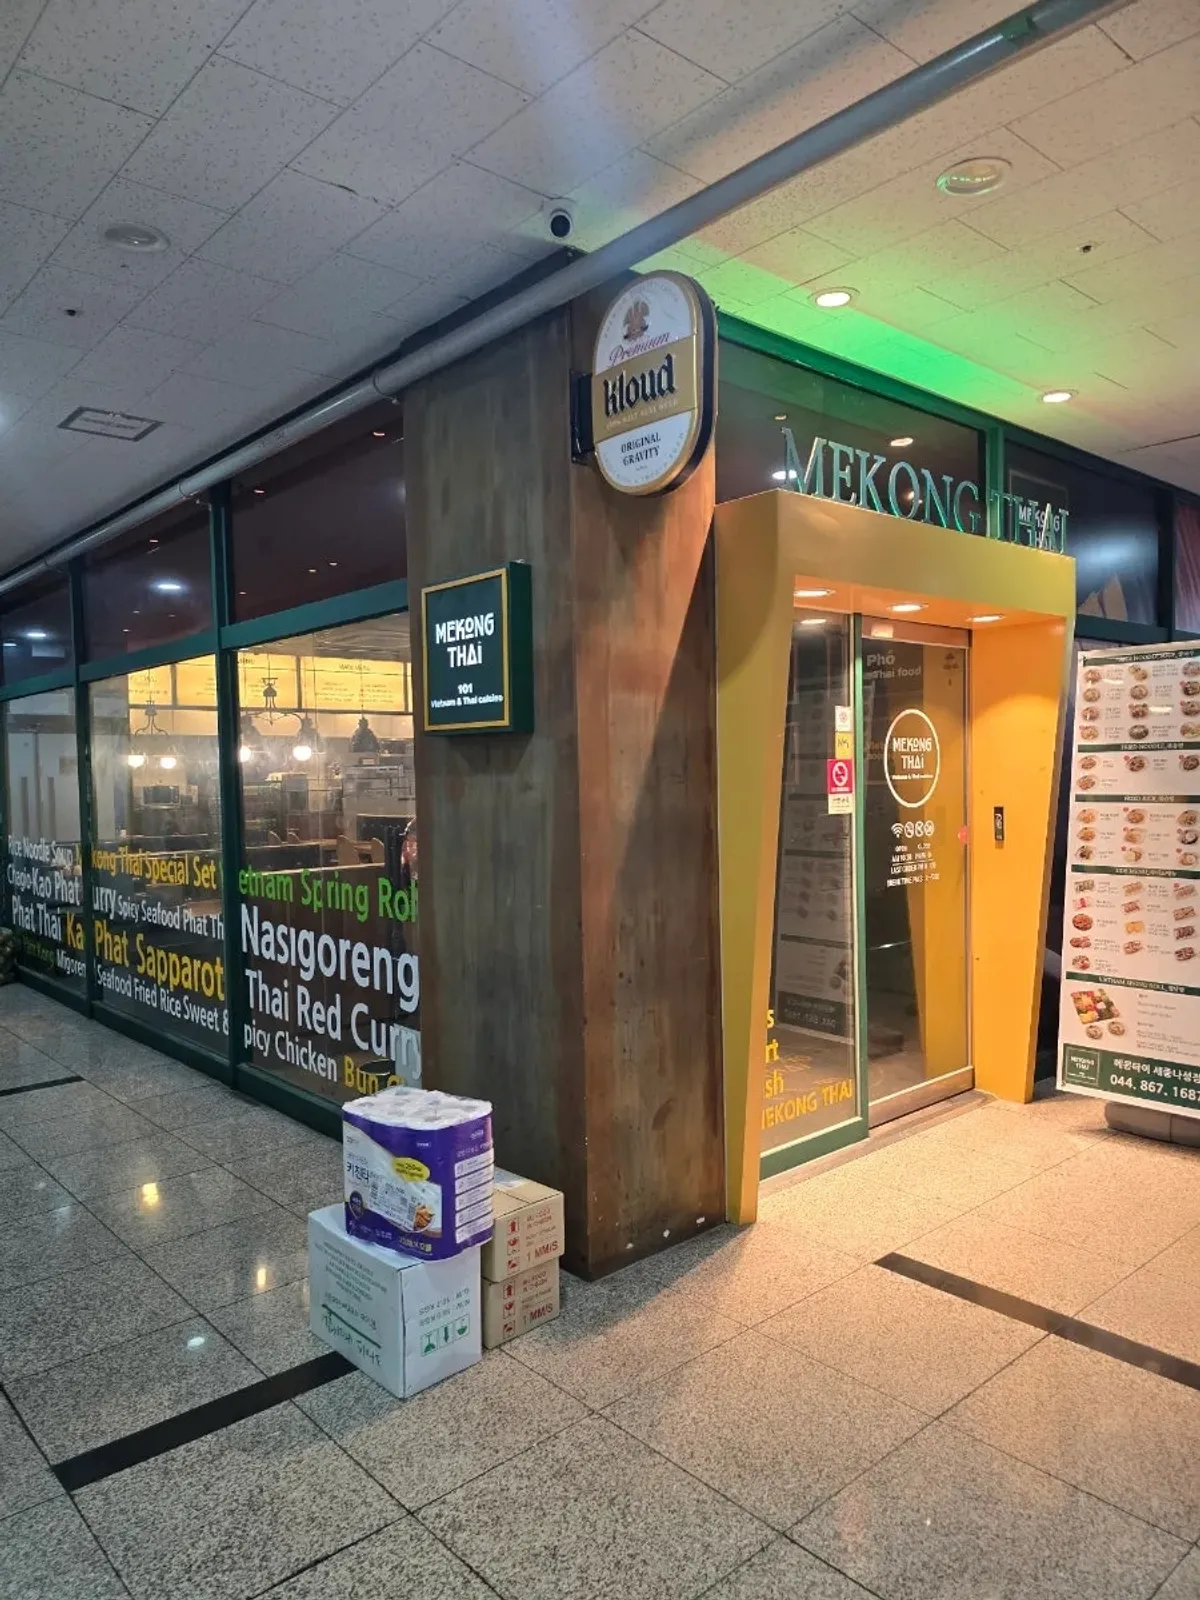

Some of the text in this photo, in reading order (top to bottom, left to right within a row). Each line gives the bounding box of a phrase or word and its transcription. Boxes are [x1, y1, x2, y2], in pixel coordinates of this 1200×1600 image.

[621, 432, 661, 453] ORIGINAL
[623, 446, 660, 466] GRAVITY
[781, 426, 981, 533] MEKONG
[989, 489, 1069, 555] THAI
[435, 612, 495, 645] MEKONG
[457, 683, 473, 695] 101
[897, 666, 922, 677] food
[457, 697, 462, 706] &
[462, 695, 478, 705] Thai
[893, 737, 932, 752] MEKONG
[32, 866, 52, 898] Kao
[54, 870, 80, 906] Phat
[119, 845, 143, 877] Thai
[145, 850, 189, 886] Special
[193, 855, 217, 890] Set
[118, 895, 139, 923] Spicy
[141, 899, 180, 931] Seafood
[183, 907, 208, 936] Phat
[301, 868, 369, 923] Spring
[12, 895, 35, 933] Phat
[36, 902, 62, 941] Thai
[94, 920, 129, 968] Phat
[136, 933, 225, 1001] Sapparot
[241, 903, 420, 1013] Nasigoreng
[97, 964, 132, 998] Seafood
[134, 977, 157, 1009] Fried
[160, 989, 181, 1018] Rice
[183, 994, 219, 1032] Sweet
[245, 968, 290, 1022] Thai
[297, 984, 341, 1041] Red
[274, 1030, 338, 1082] Chicken
[821, 1079, 853, 1106] THAI
